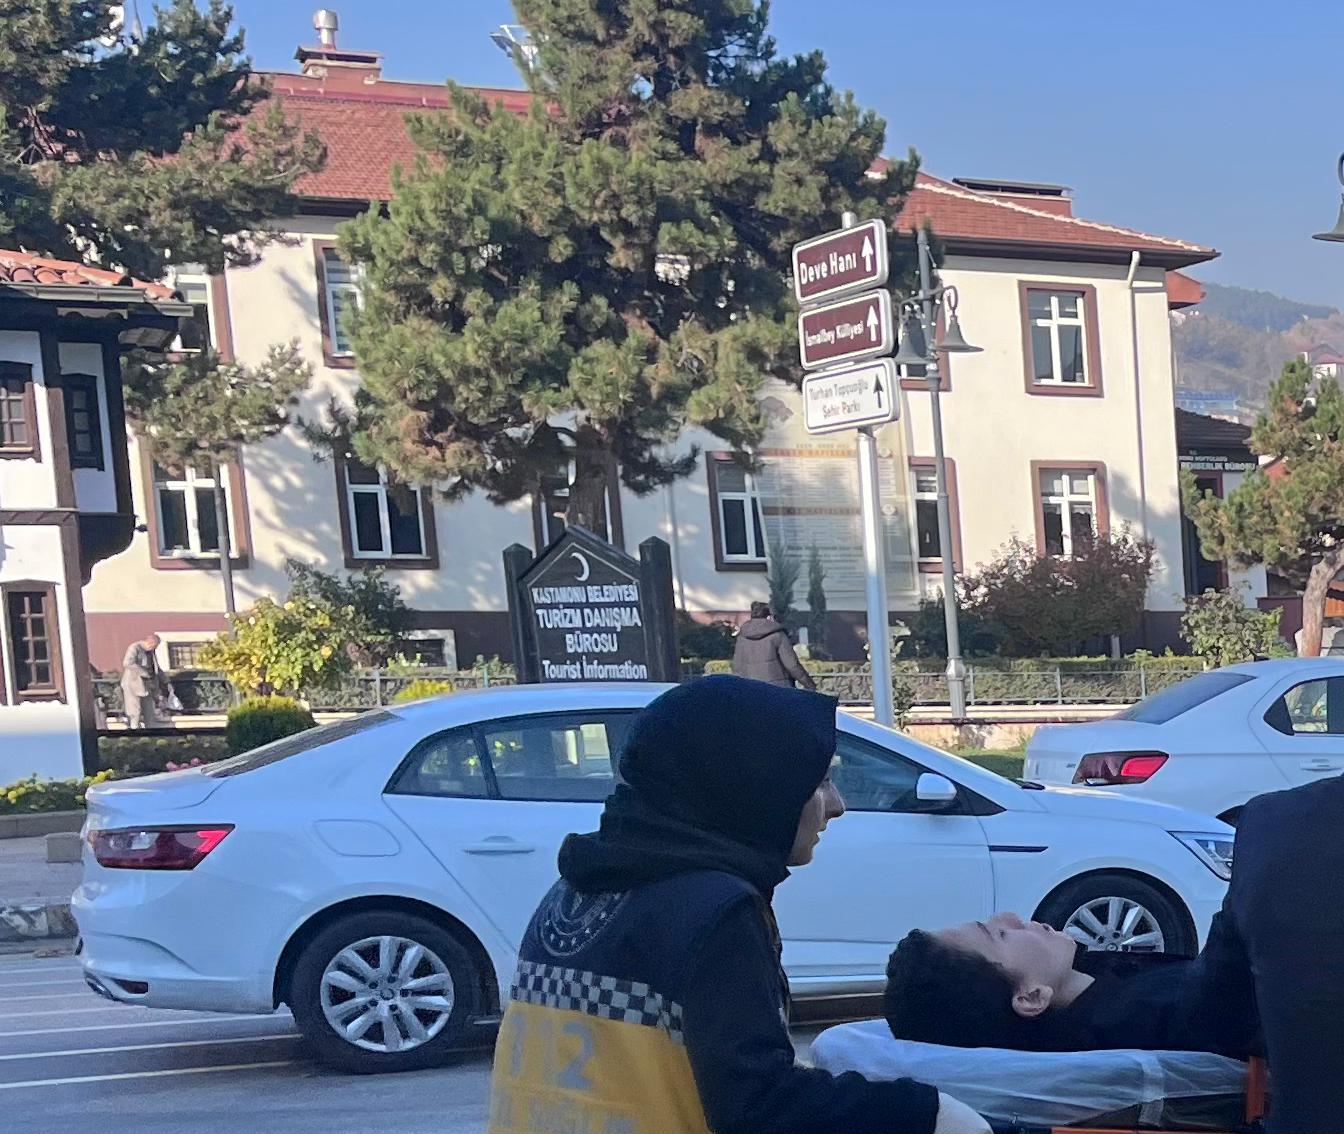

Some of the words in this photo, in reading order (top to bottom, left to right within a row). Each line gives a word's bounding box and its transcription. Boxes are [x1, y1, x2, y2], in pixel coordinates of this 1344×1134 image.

[800, 261, 828, 285] Deve
[829, 251, 857, 276] Hanı
[531, 586, 586, 604] KASTAMONU
[535, 603, 582, 629] TURİZM
[583, 606, 642, 632] DANIŞMA
[565, 630, 618, 654] BÜROSU
[542, 659, 581, 679] Tourist
[510, 1011, 597, 1091] 112
